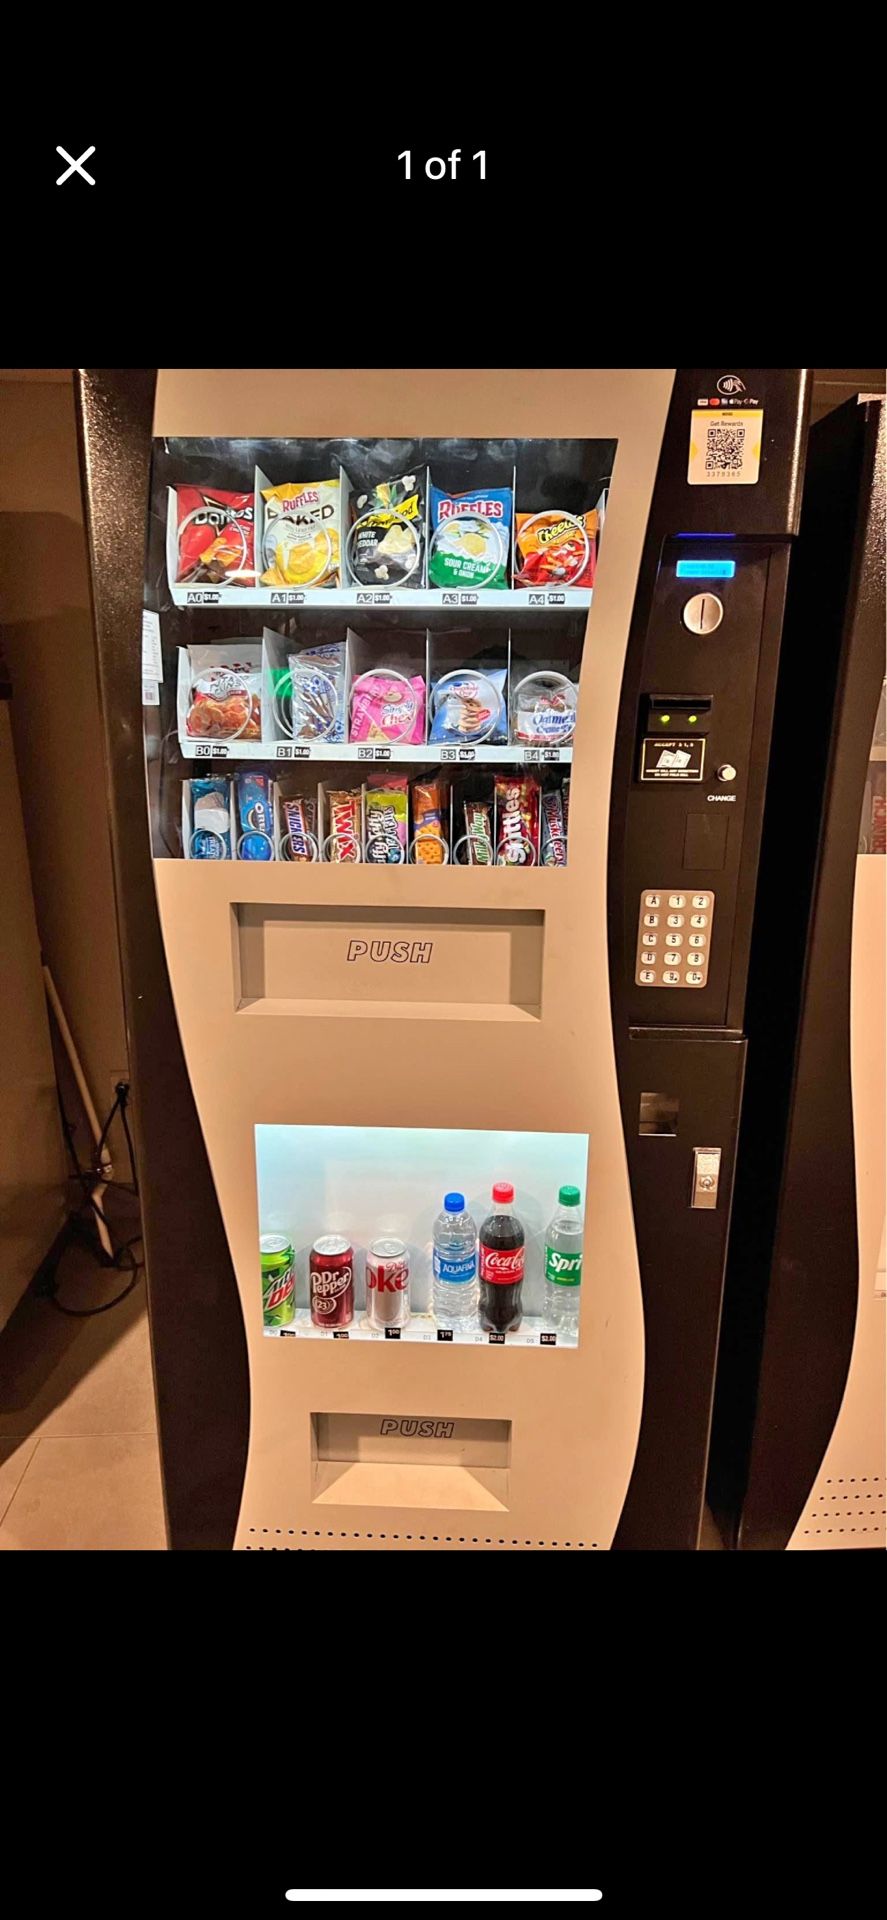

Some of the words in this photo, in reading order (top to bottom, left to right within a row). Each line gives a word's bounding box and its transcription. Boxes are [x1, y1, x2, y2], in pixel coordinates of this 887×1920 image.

[283, 491, 319, 512] RUFFLES
[438, 501, 502, 521] RUFFLES
[444, 558, 461, 568] SOUR
[462, 561, 485, 574] CREAM
[188, 594, 202, 603] A0
[272, 594, 286, 602] A1
[358, 594, 373, 603] A2
[443, 594, 458, 603] A3
[529, 594, 544, 604] A4
[196, 746, 210, 755] B0
[277, 747, 291, 757] B1
[358, 749, 373, 758] B2
[441, 750, 455, 759] B3
[255, 802, 266, 832] ORE
[287, 803, 305, 854] SNICKERS
[347, 940, 433, 963] PUSH
[442, 1260, 475, 1274] AQUAFINA
[549, 1252, 584, 1273] Spri
[311, 1272, 350, 1296] Pepper
[322, 1271, 339, 1284] Dr
[380, 1418, 454, 1438] PUSH
